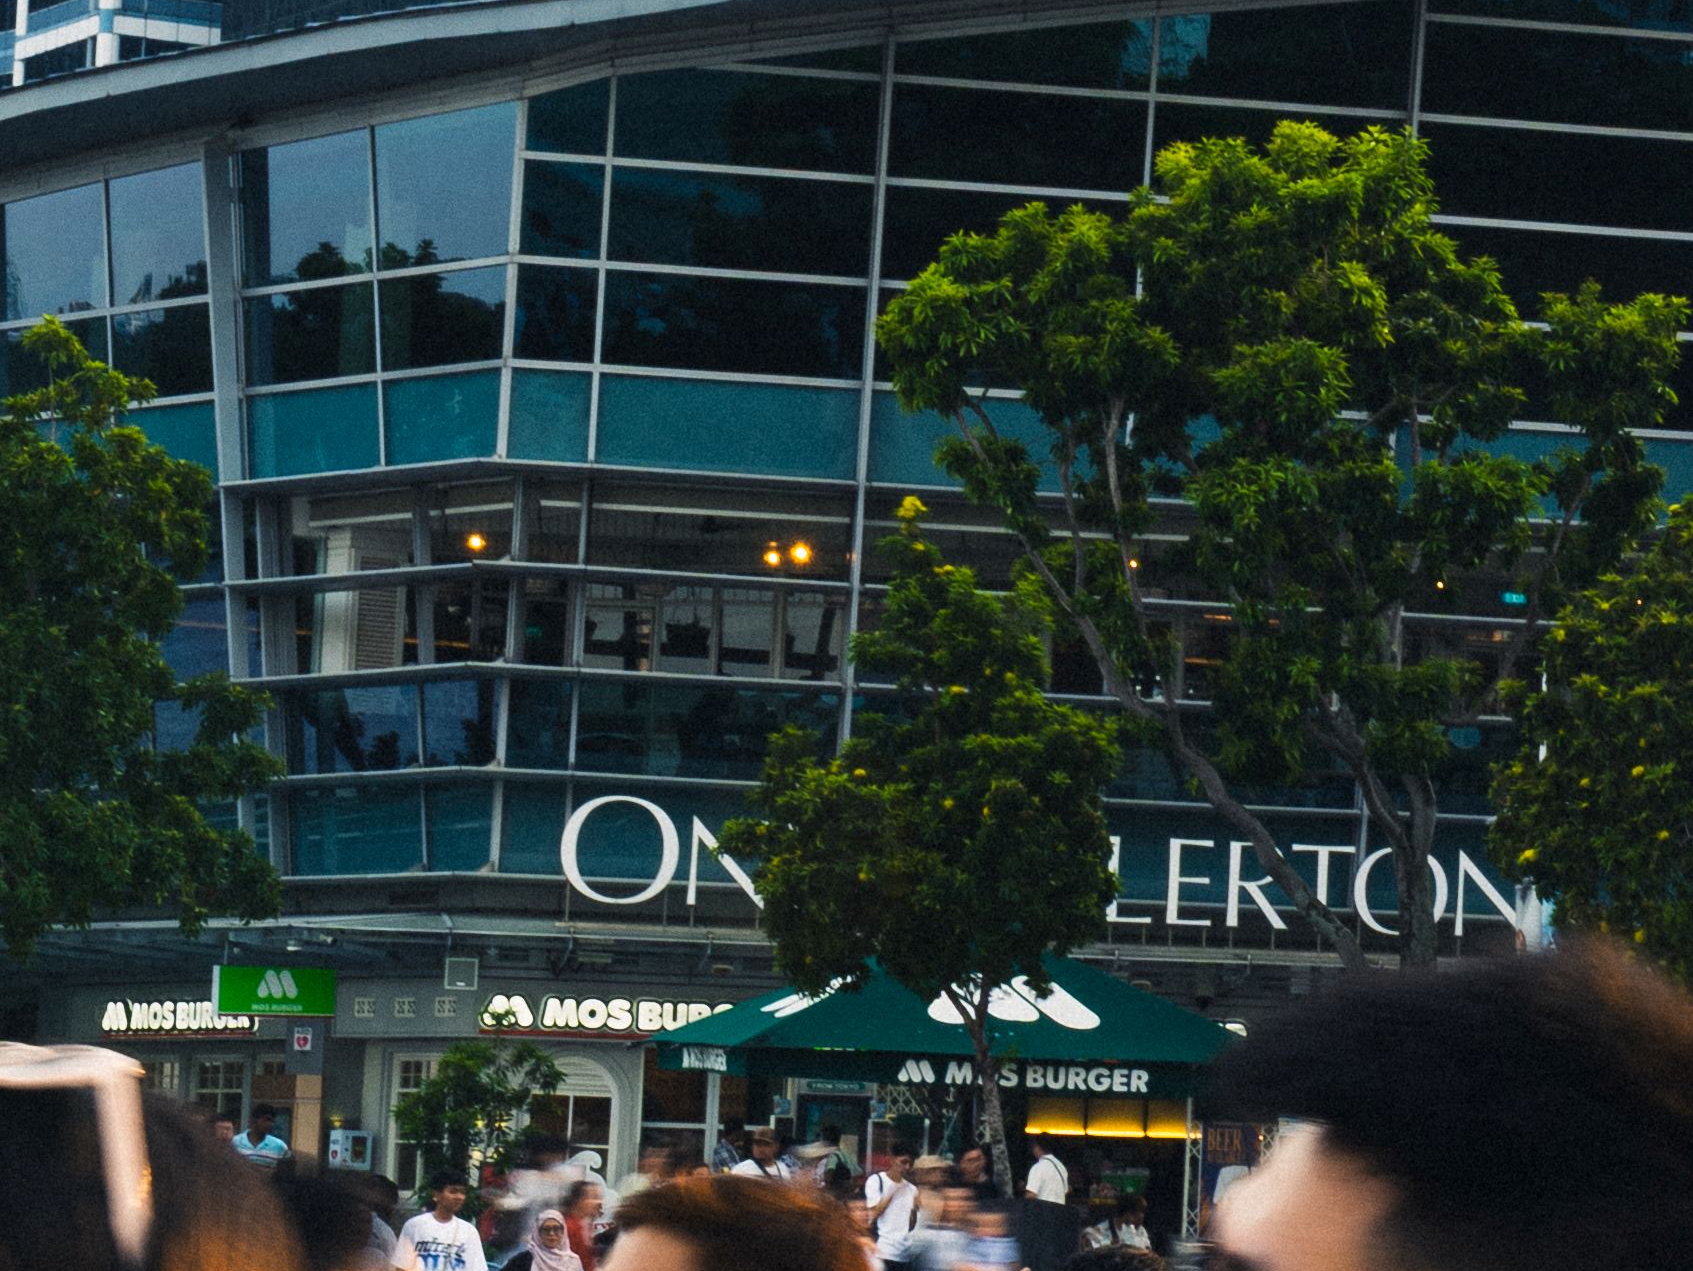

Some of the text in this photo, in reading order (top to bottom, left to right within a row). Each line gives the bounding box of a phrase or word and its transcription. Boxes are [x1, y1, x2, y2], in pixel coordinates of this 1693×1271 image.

[129, 1000, 175, 1030] MOS
[542, 996, 633, 1031] MOS
[944, 1060, 1150, 1094] MS BURGER
